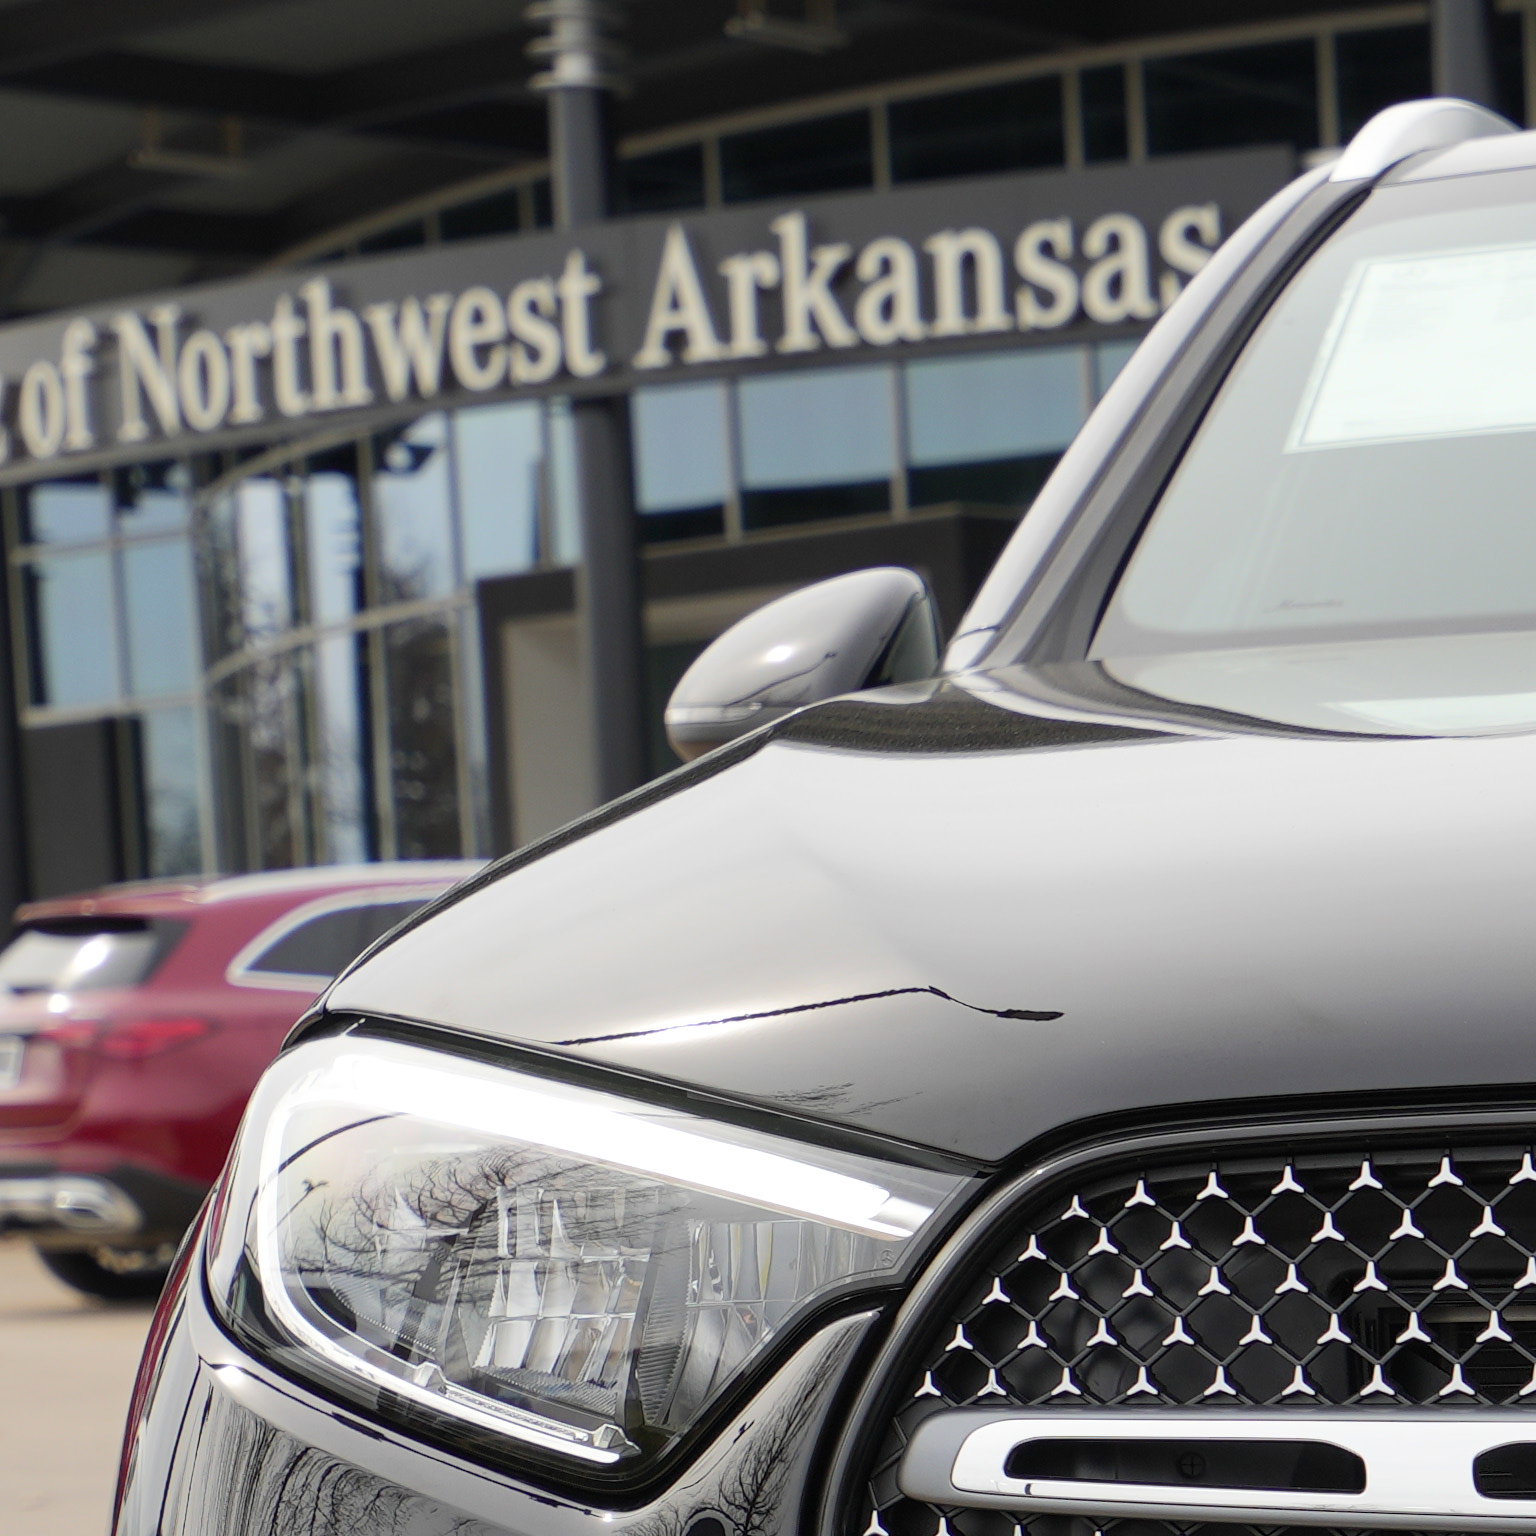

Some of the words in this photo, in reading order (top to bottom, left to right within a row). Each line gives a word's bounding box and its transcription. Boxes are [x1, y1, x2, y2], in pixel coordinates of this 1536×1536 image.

[19, 317, 97, 460] of
[115, 250, 606, 442] Northwest
[633, 202, 1223, 368] Arkansas
